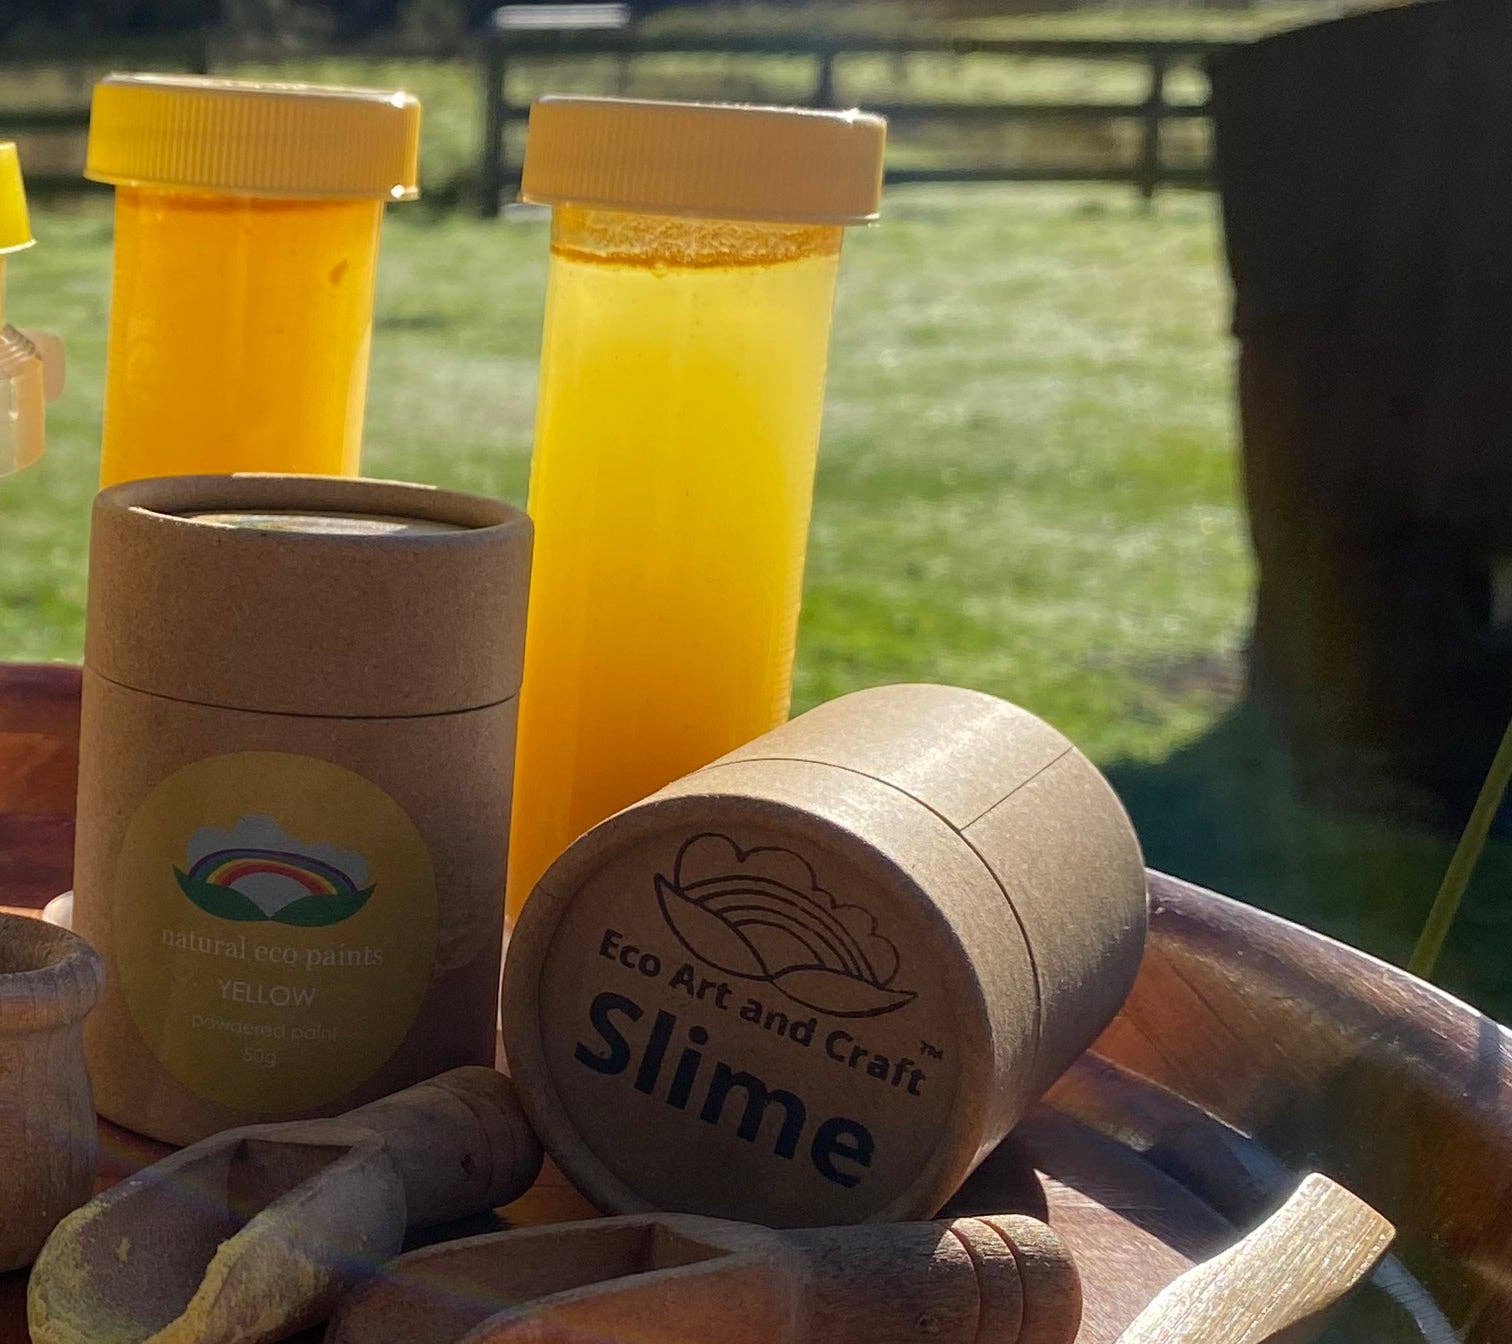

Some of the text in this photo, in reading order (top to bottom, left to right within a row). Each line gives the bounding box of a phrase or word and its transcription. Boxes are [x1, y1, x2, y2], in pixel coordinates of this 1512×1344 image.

[162, 928, 384, 971] natural eco paints
[217, 979, 317, 1009] YELLOW
[598, 927, 661, 978] Eco
[668, 963, 733, 1011] Art
[739, 997, 817, 1047] and
[192, 1014, 286, 1042] powdered
[573, 991, 876, 1189] Slime
